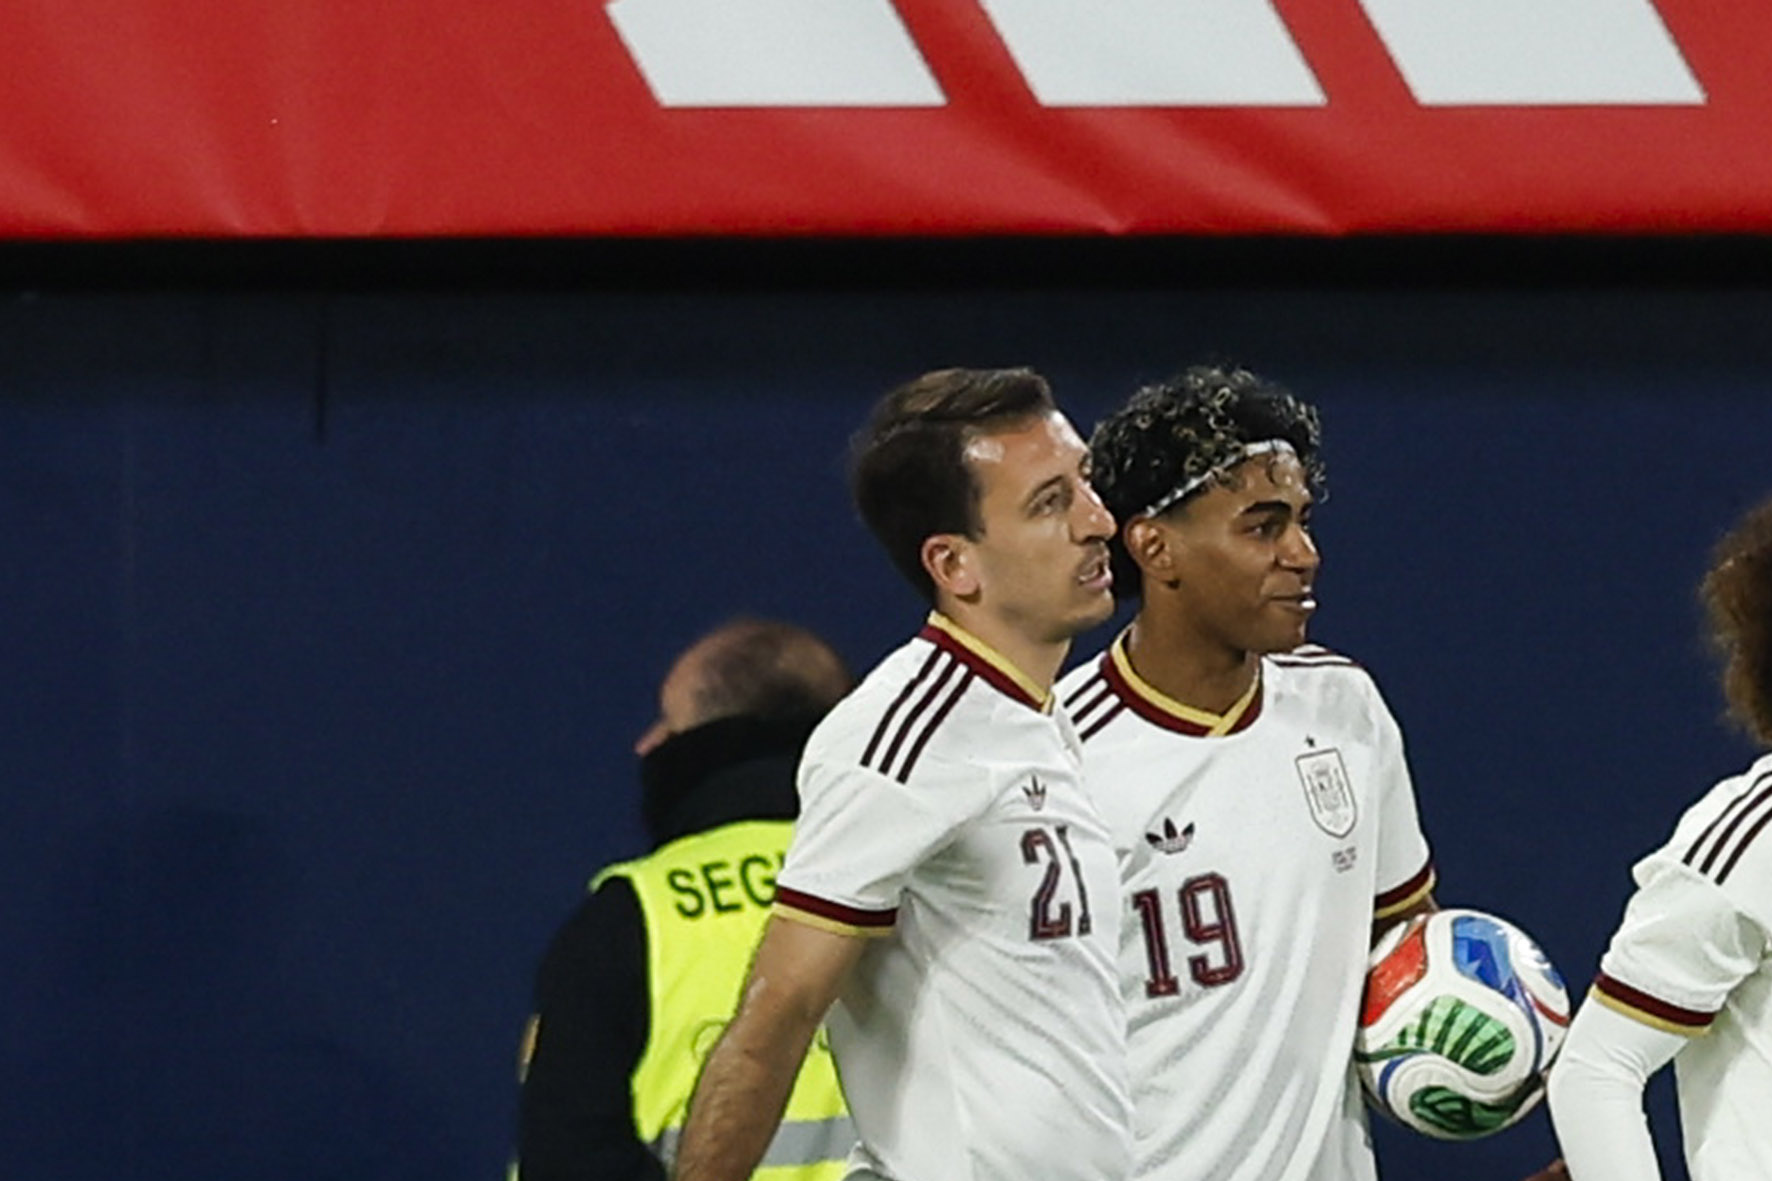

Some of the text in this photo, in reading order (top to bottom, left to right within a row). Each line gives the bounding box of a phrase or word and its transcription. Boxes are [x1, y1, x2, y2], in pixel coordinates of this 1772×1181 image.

[667, 851, 786, 920] SEG
[1020, 826, 1092, 941] 21
[1131, 871, 1245, 999] 19
